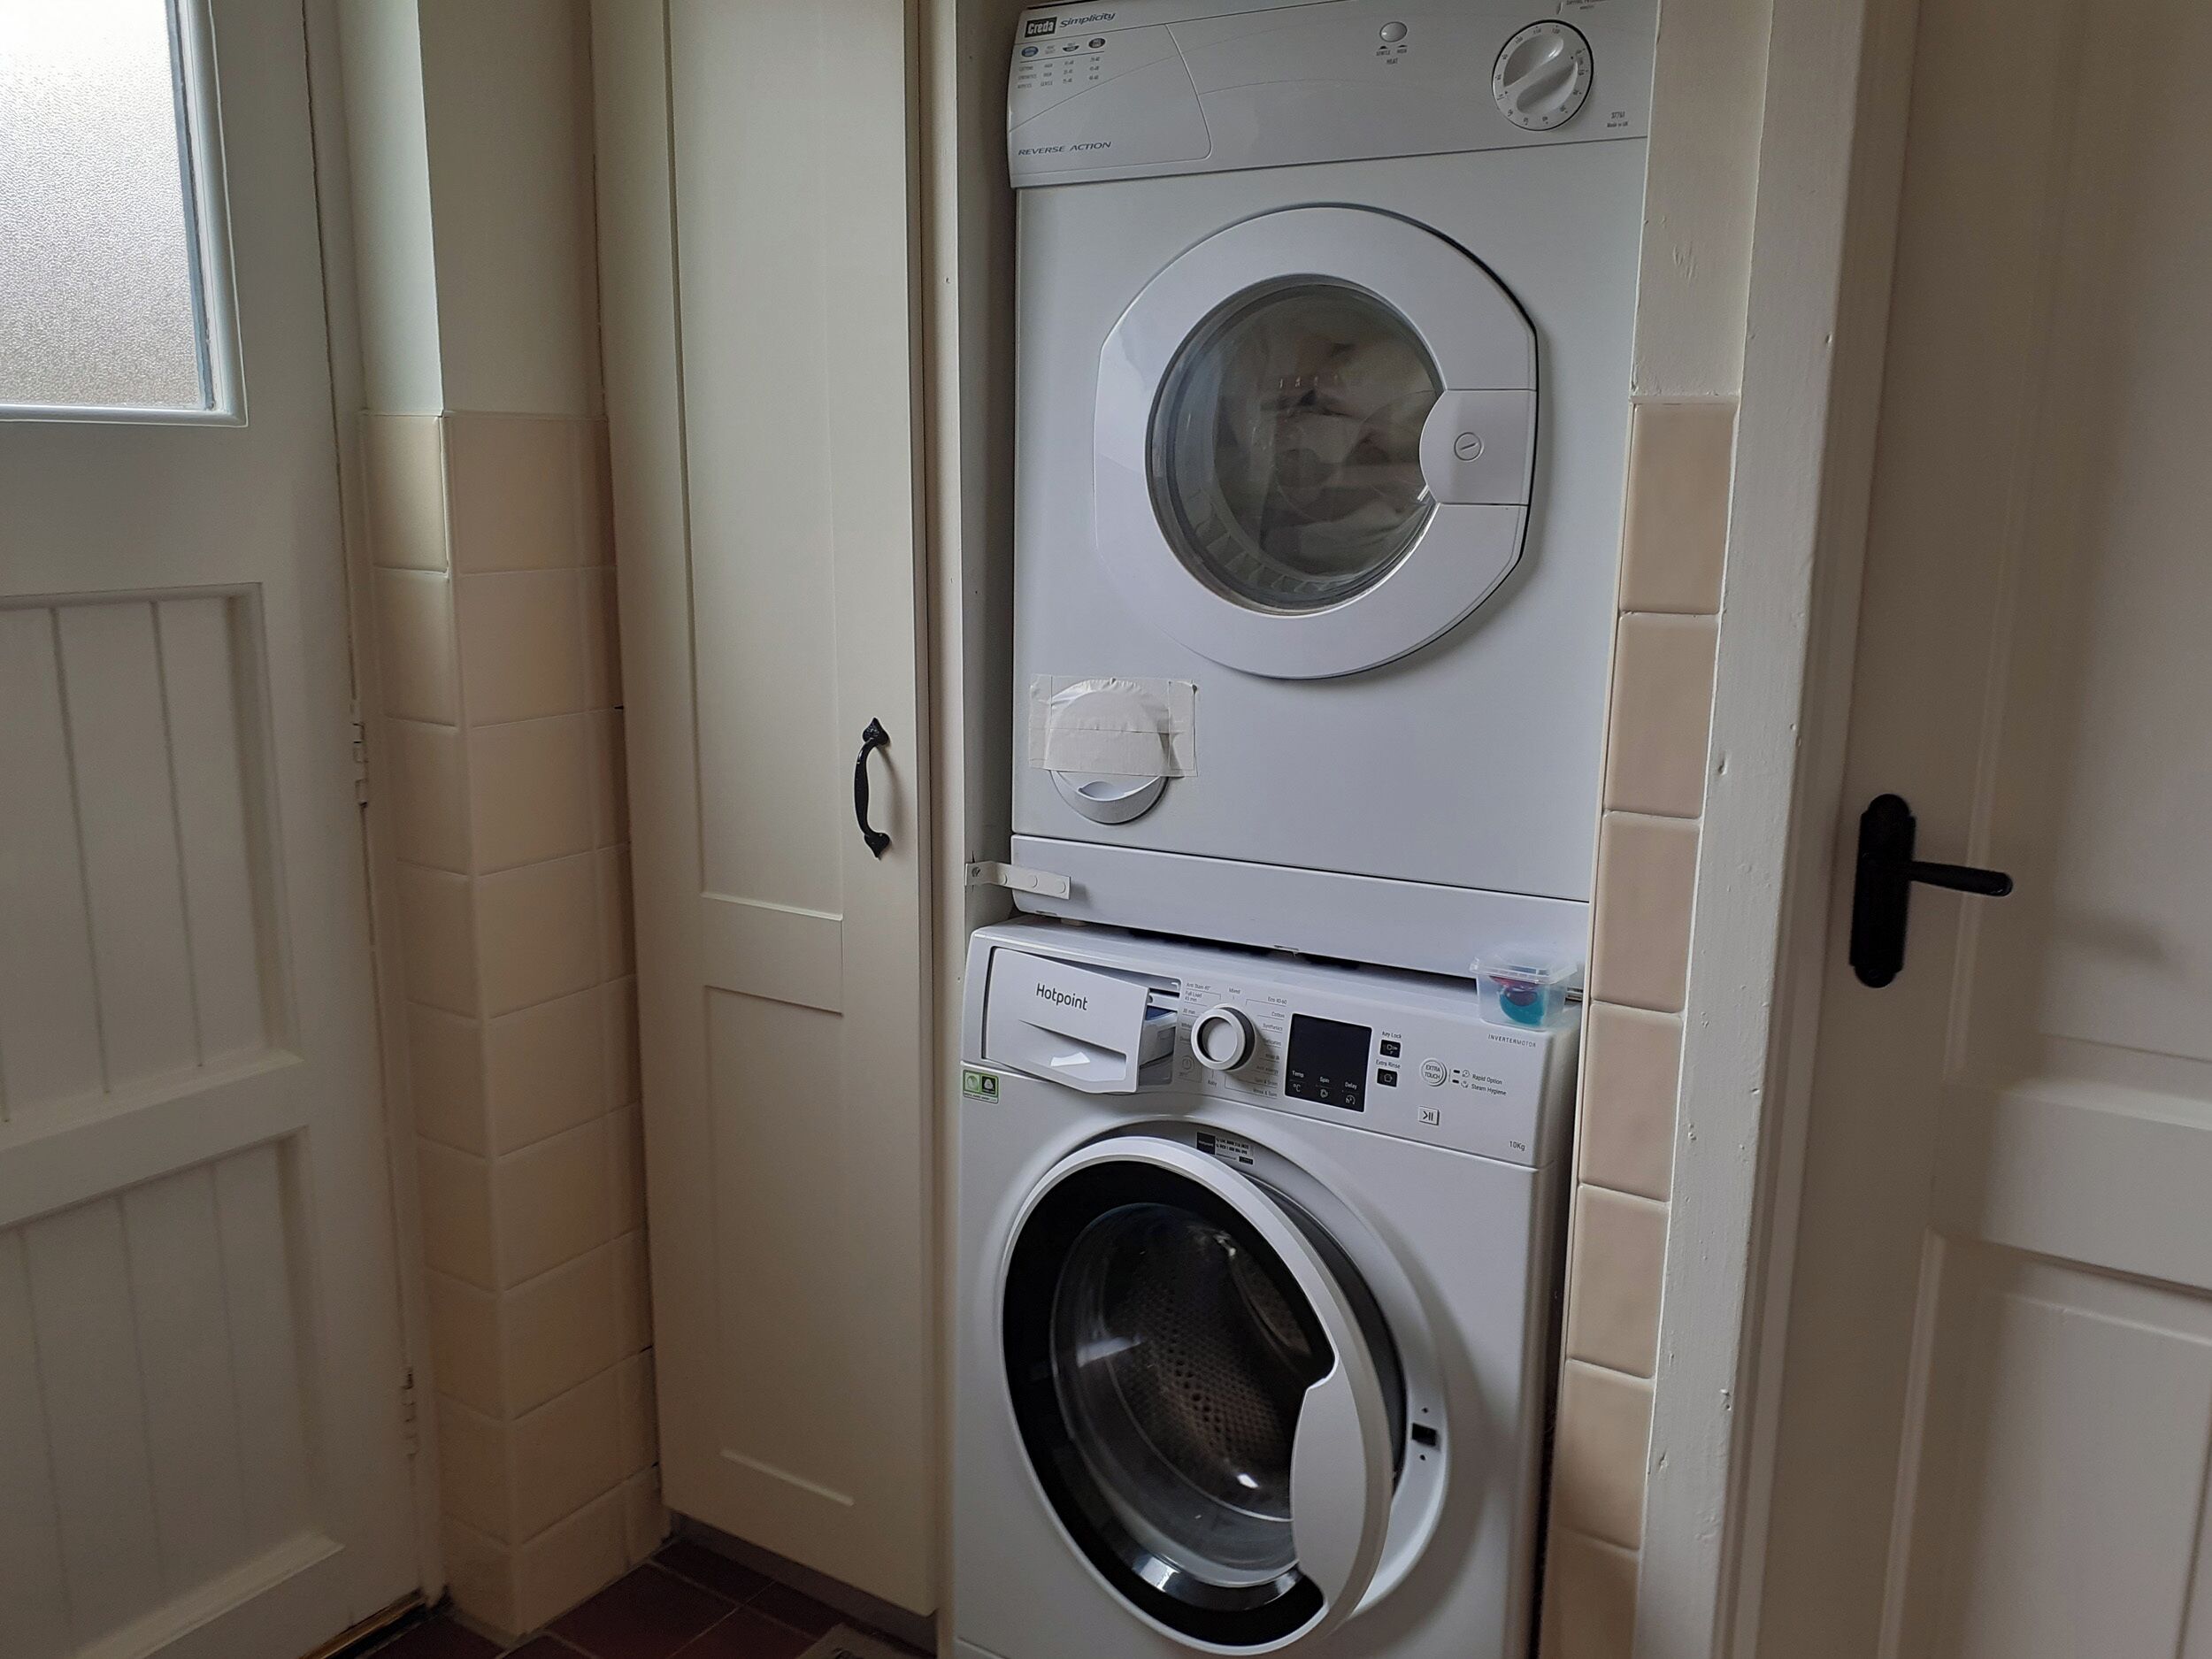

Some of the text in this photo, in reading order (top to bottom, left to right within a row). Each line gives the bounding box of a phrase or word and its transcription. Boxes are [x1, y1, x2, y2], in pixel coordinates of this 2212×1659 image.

[1026, 20, 1055, 35] Creda
[1018, 141, 1111, 156] REVERSE ACTION
[1036, 982, 1088, 1010] Hotpoint
[1488, 1033, 1536, 1048] INVERTERMOTOR
[1345, 1081, 1357, 1090] Delay
[1486, 1077, 1502, 1086] Option
[1487, 1086, 1507, 1096] Hygiene
[1509, 1141, 1525, 1151] 10Kg
